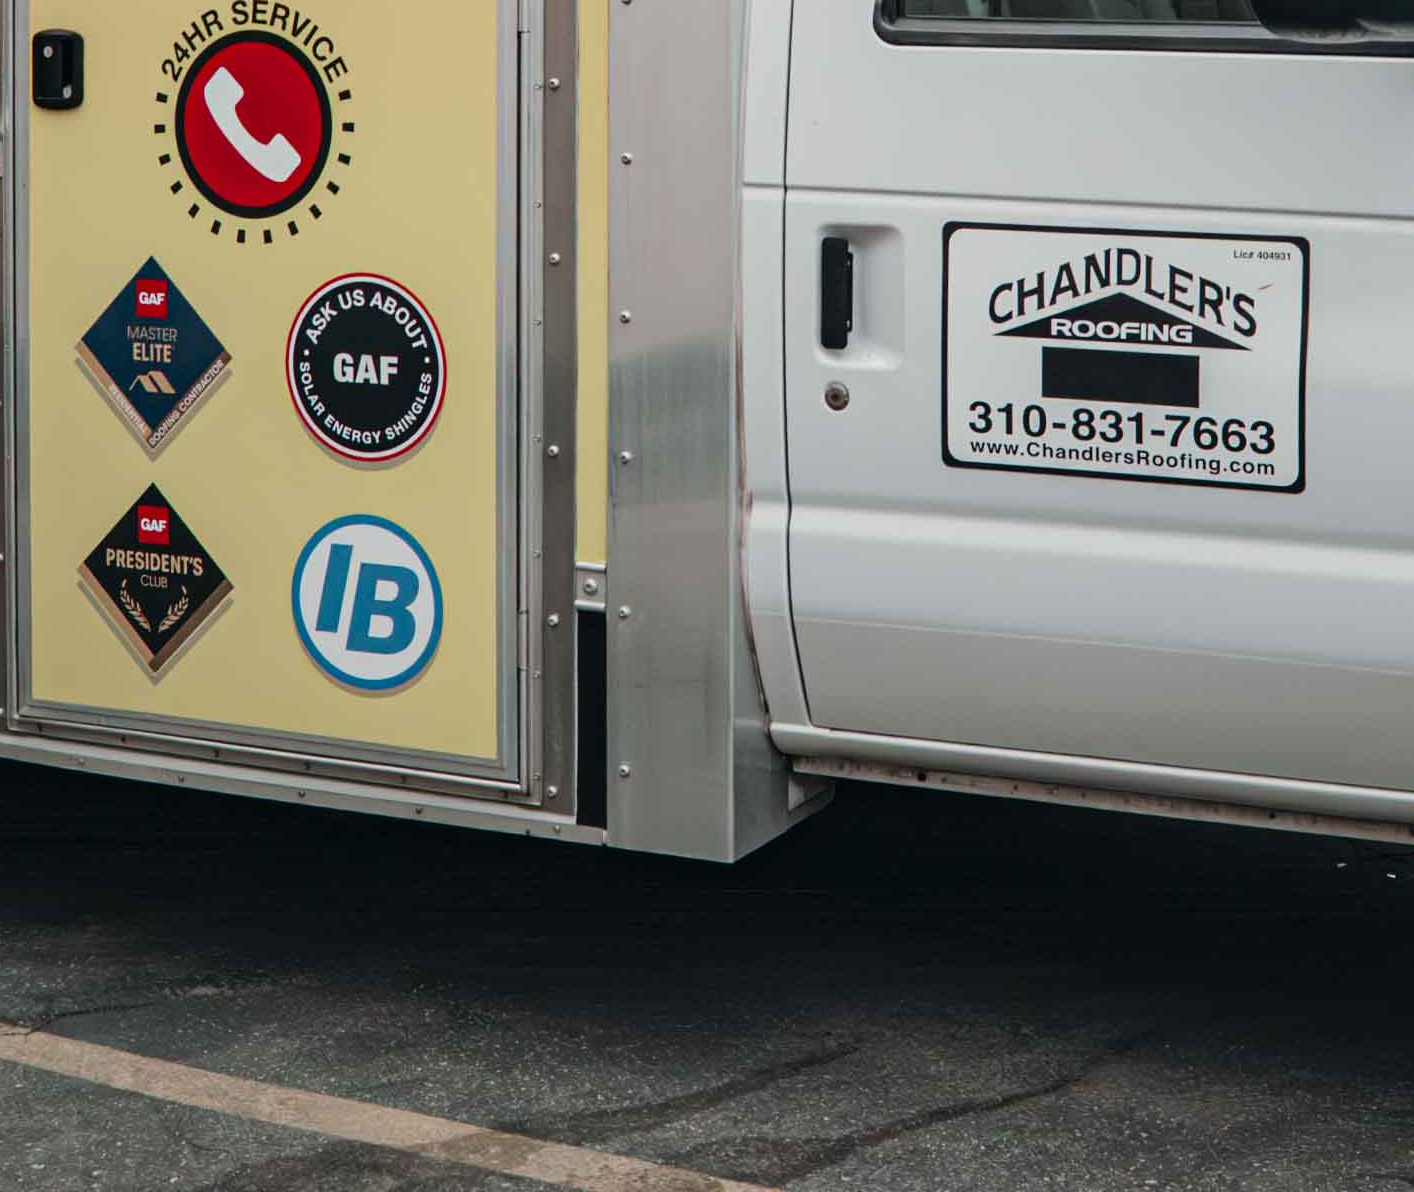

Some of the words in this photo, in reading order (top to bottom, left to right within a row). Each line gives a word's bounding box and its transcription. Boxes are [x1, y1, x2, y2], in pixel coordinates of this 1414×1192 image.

[161, 8, 224, 83] 24HR
[231, 0, 348, 84] SERVICE
[139, 291, 166, 305] GAF
[988, 247, 1257, 337] CHANDLER'S
[126, 325, 178, 342] MASTER
[306, 301, 338, 345] ASK
[337, 289, 366, 310] US
[370, 291, 428, 350] ABOUT
[1050, 318, 1193, 344] ROOFING
[132, 343, 173, 363] ELITE
[333, 353, 399, 385] GAF
[299, 361, 325, 417] SOLAR
[324, 414, 382, 445] ENERGY
[384, 372, 433, 441] SHINGLES
[968, 400, 1276, 455] 310-831-7663
[970, 440, 1275, 476] www.ChandlersRoofing.com
[140, 517, 167, 532] GAF
[106, 547, 204, 577] PRESIDENT'S
[140, 574, 168, 589] CLUB
[315, 542, 420, 655] IB
